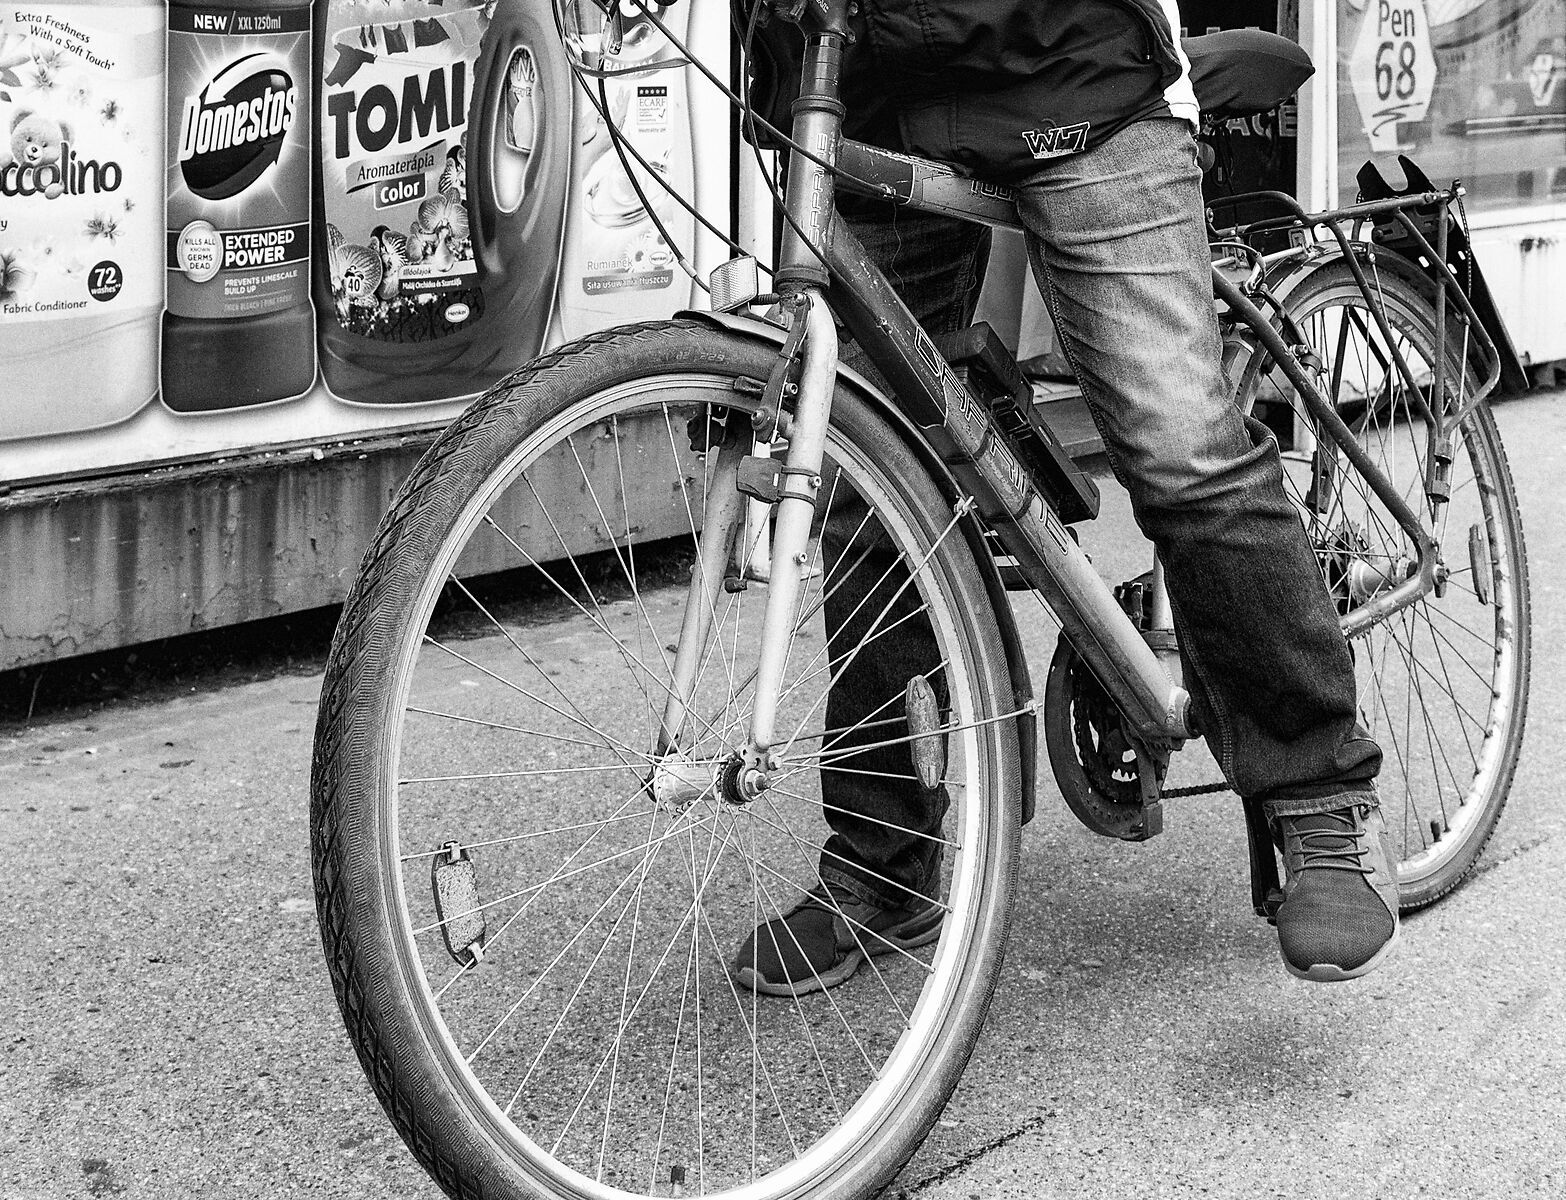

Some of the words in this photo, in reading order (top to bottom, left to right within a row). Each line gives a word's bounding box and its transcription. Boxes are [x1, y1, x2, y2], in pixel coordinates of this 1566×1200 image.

[14, 11, 42, 22] Extra
[45, 15, 91, 43] Freshness
[193, 14, 228, 30] NEW
[238, 15, 253, 30] XXL
[254, 15, 281, 31] 1250ml
[1378, 0, 1415, 38] Pen
[30, 24, 54, 41] With
[55, 37, 62, 45] a
[63, 39, 85, 57] Soft
[1375, 41, 1416, 102] 68
[327, 61, 466, 160] TOMI
[639, 98, 666, 107] ECARF
[178, 85, 299, 161] Domestos
[1022, 121, 1091, 156] W7
[0, 142, 122, 197] ccolino
[356, 152, 434, 181] Aromaterápia
[380, 179, 420, 203] Color
[203, 238, 216, 246] ALL
[225, 229, 295, 250] EXTENDED
[187, 253, 213, 262] GERMS
[189, 262, 211, 270] DEAD
[225, 246, 285, 267] POWER
[587, 259, 633, 271] Rumianek
[95, 267, 117, 287] 72
[224, 276, 260, 287] PREVENTS
[261, 269, 298, 284] LIMESCALE
[347, 278, 360, 292] 40
[224, 286, 245, 295] BUILD
[246, 285, 257, 293] UP
[3, 303, 32, 314] Fabric
[35, 299, 88, 312] Conditioner
[447, 309, 466, 317] Henkel
